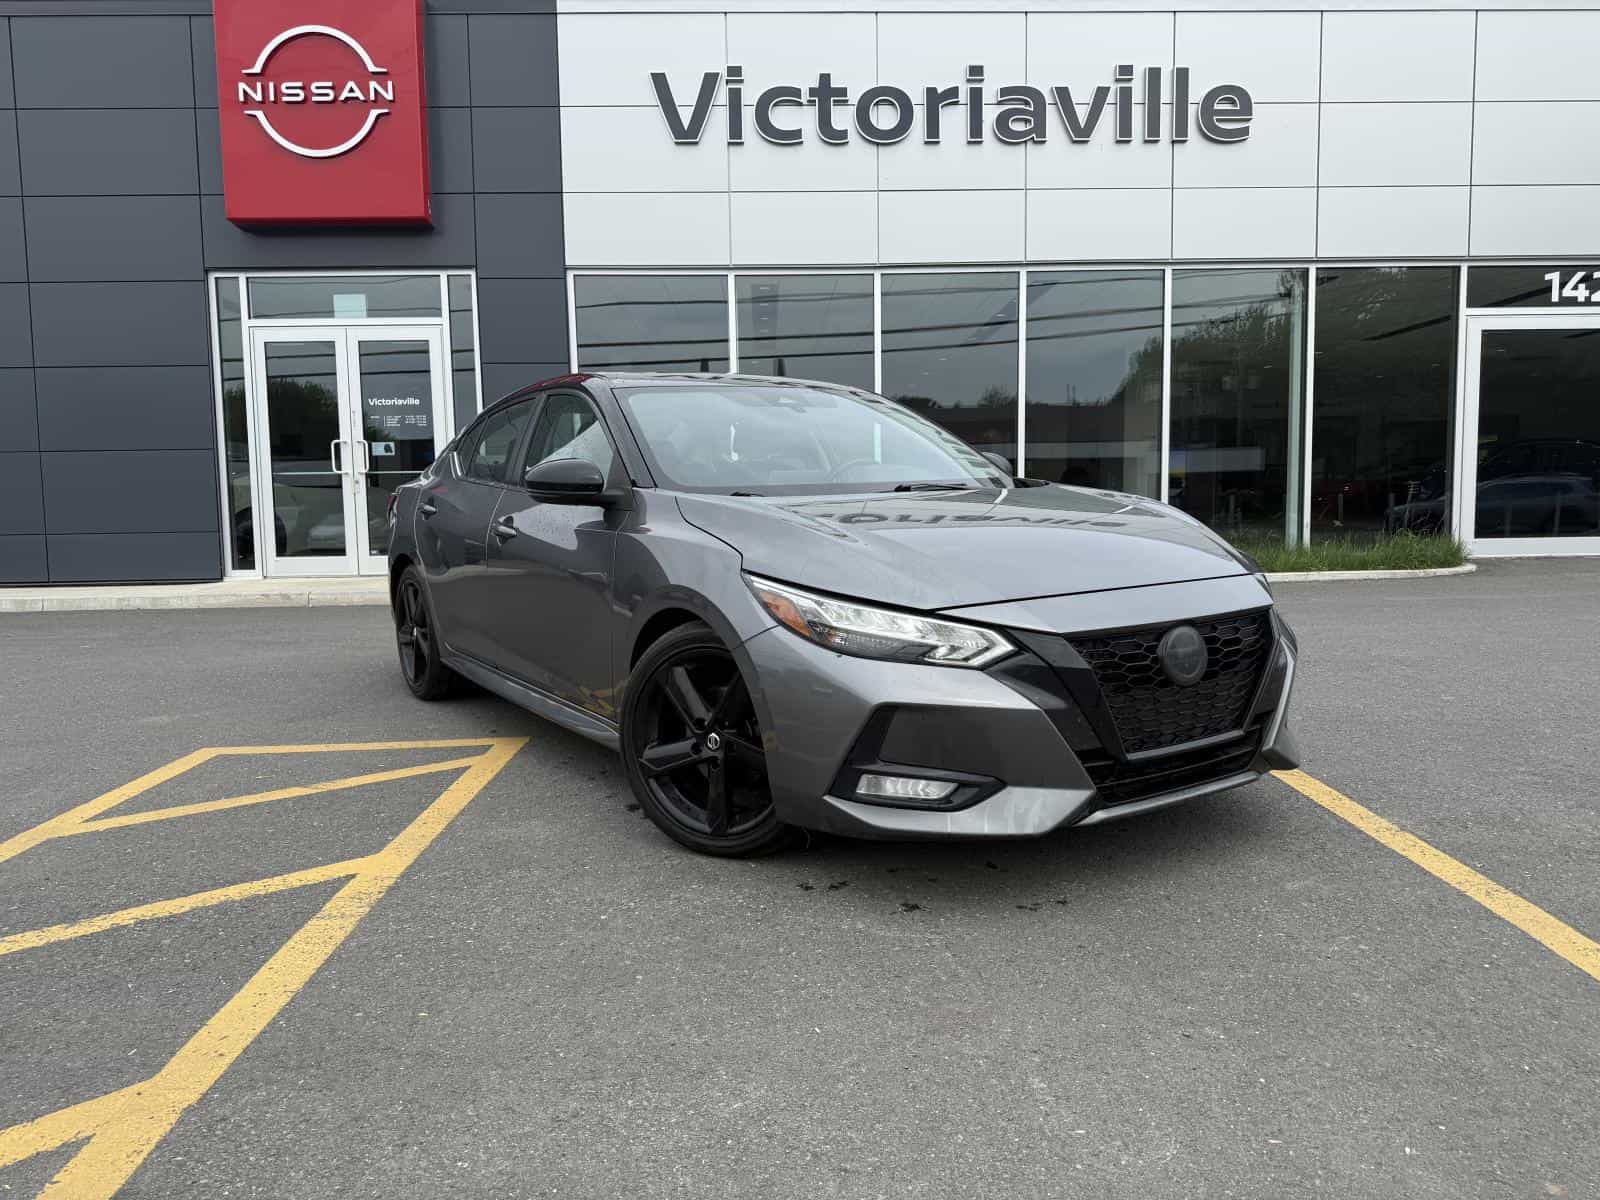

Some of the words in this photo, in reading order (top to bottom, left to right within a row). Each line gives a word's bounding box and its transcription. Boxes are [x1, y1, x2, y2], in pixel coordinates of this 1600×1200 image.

[237, 80, 395, 102] NISSAN
[650, 65, 1254, 145] Victoriaville
[368, 397, 420, 406] Victoriaville
